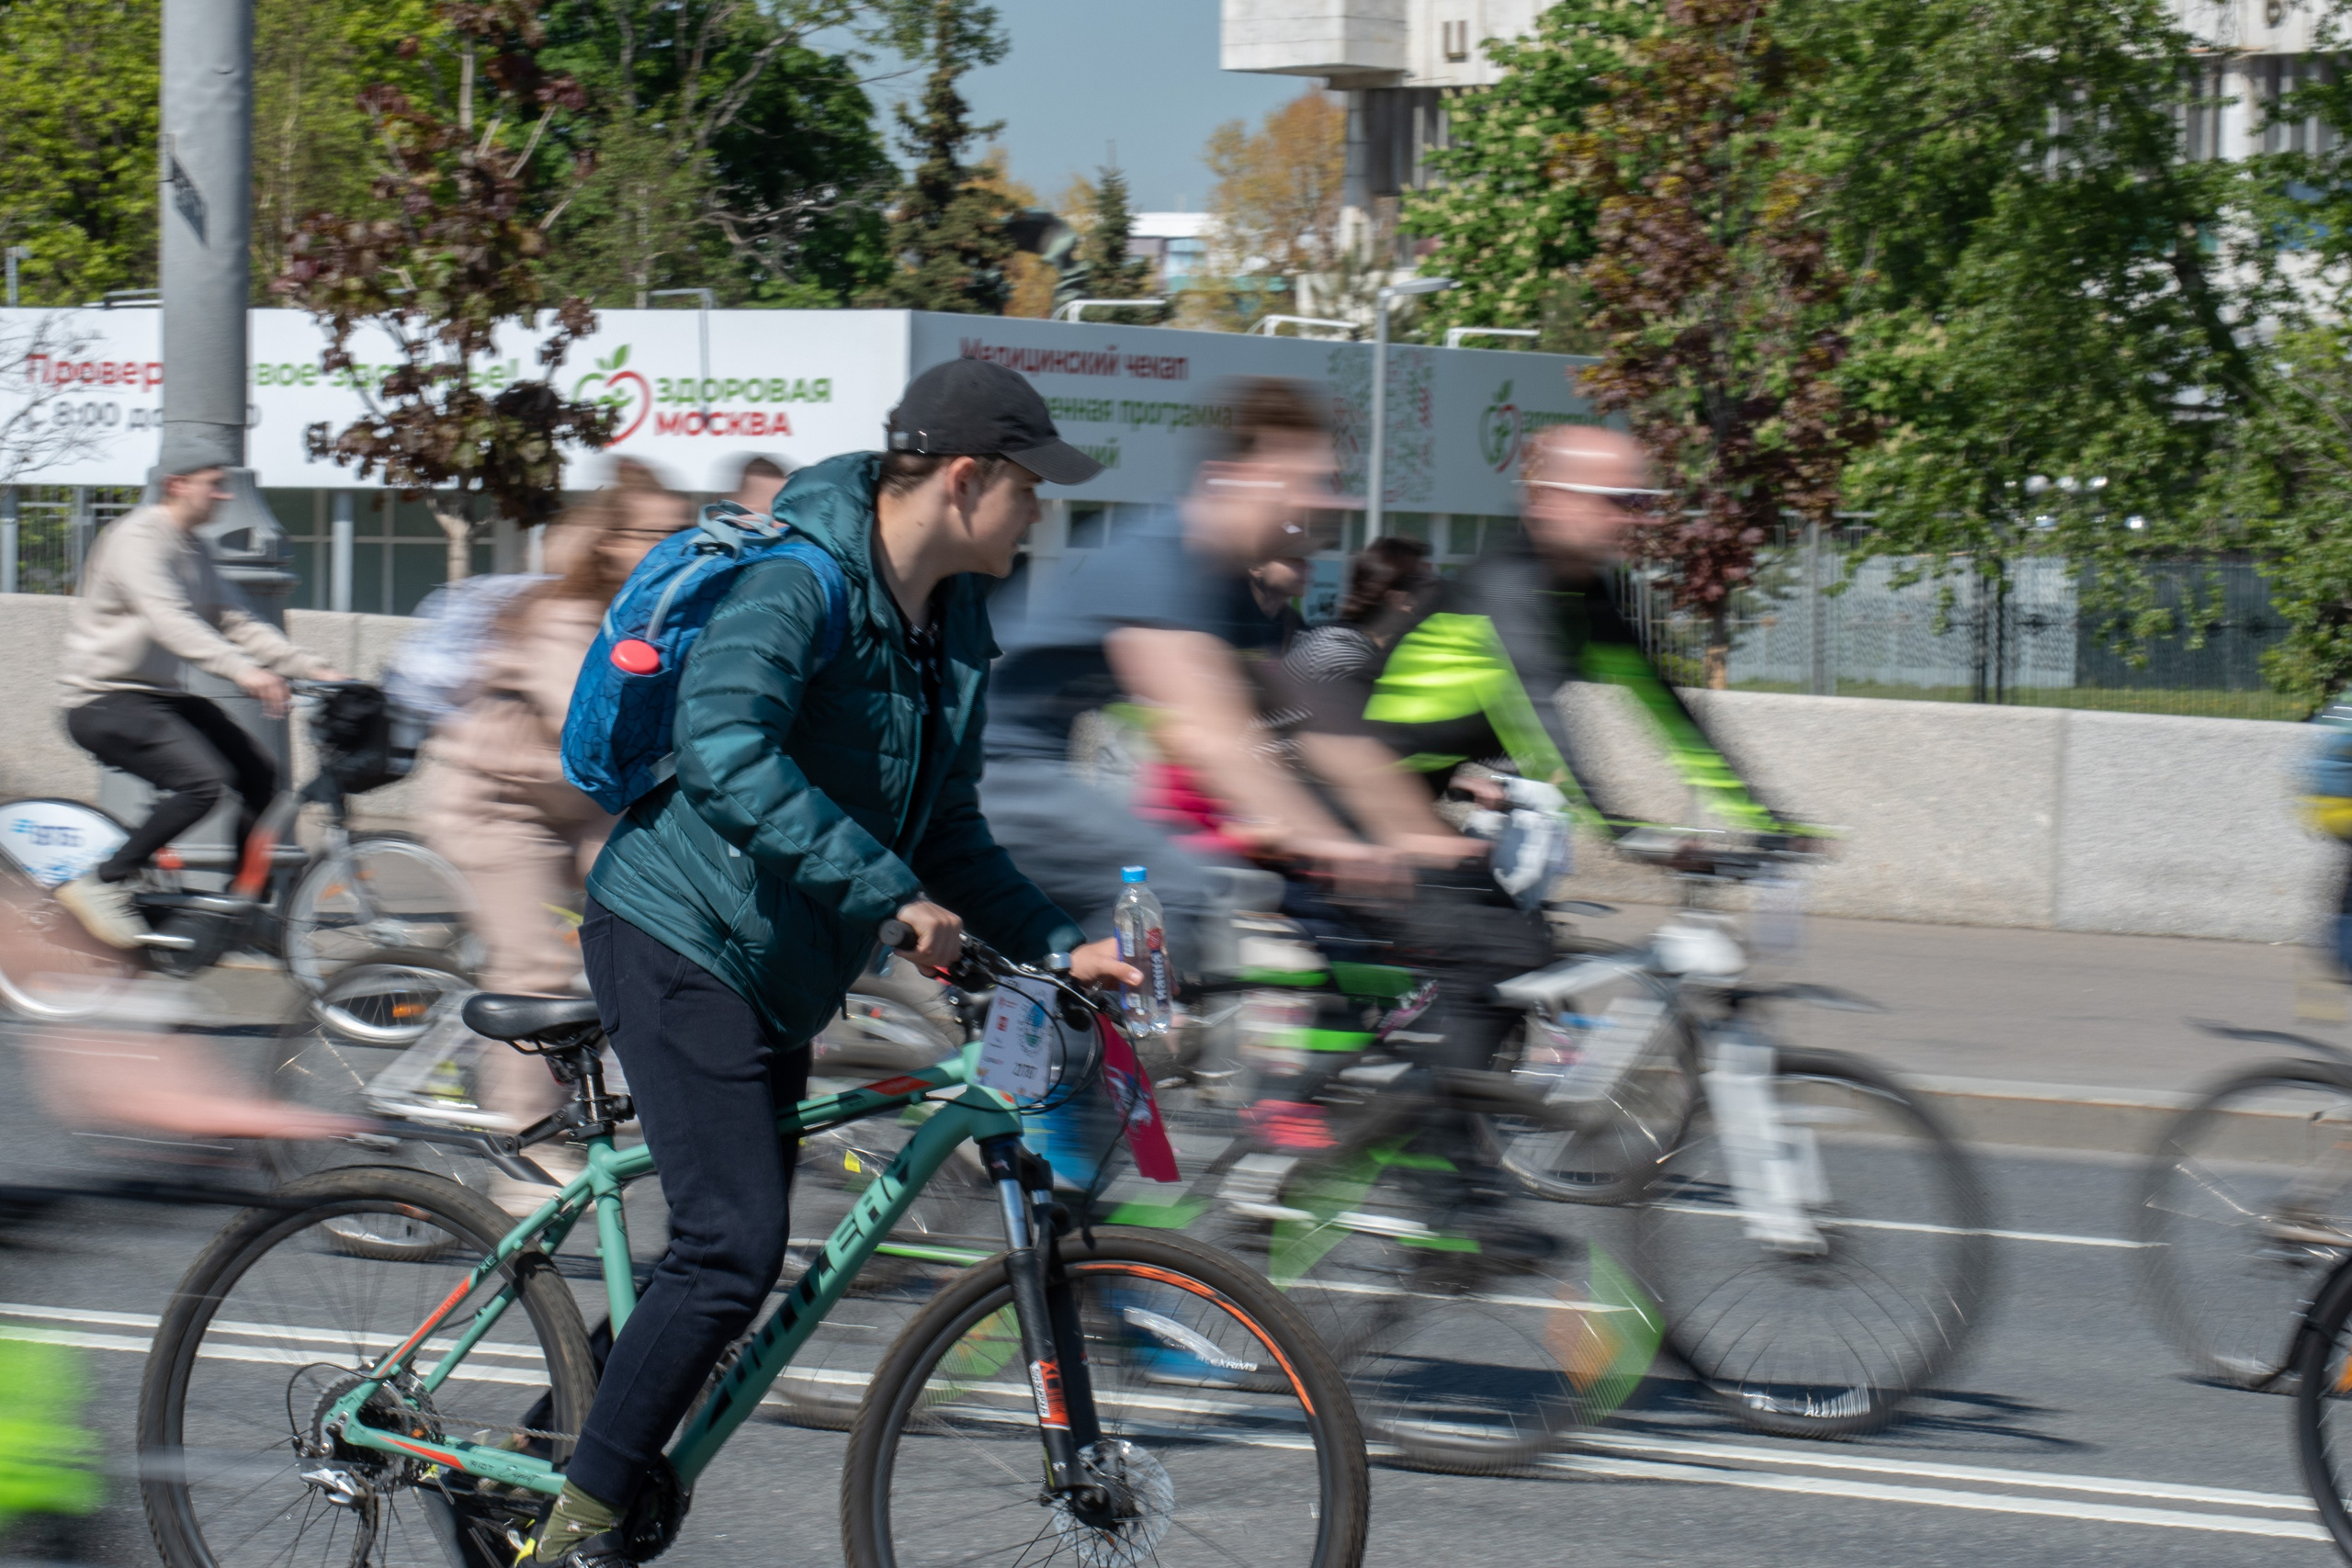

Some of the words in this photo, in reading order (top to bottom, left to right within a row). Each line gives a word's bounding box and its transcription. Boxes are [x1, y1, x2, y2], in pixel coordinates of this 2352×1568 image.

[26, 353, 164, 393] Провер
[254, 362, 318, 387] вое
[654, 377, 832, 406] ЗДОРОВАЯ
[654, 411, 793, 436] МОСКВА
